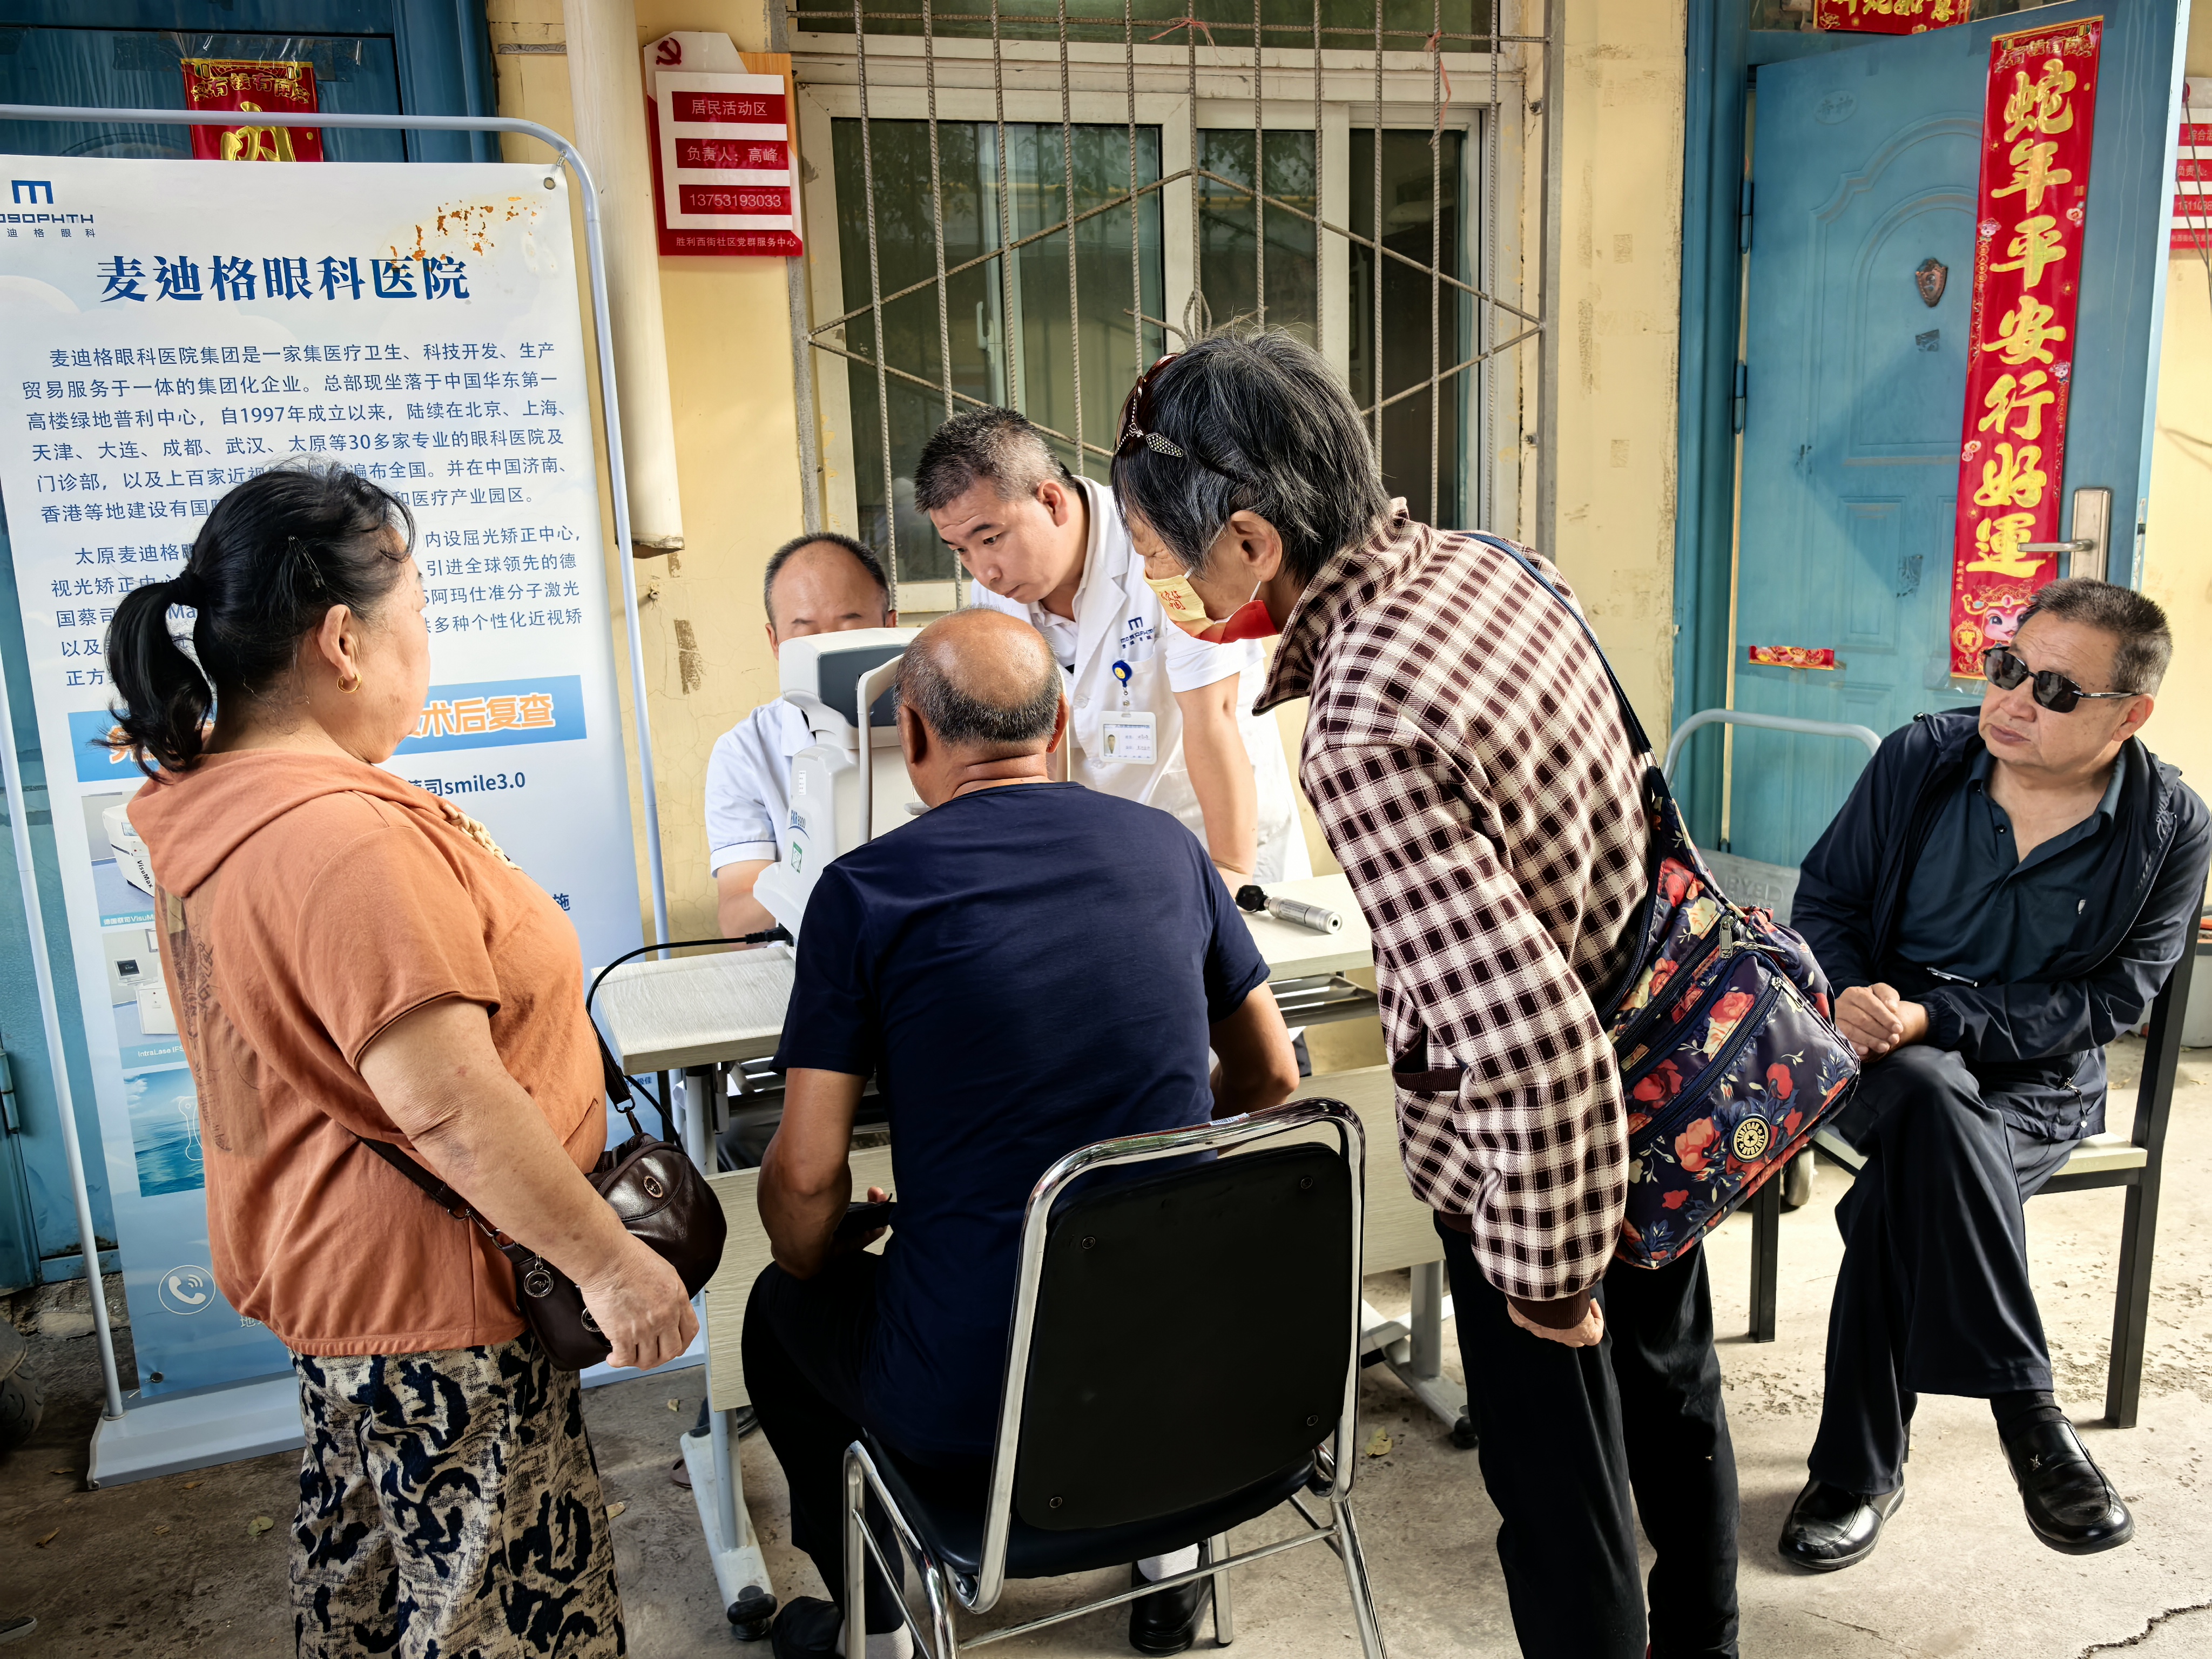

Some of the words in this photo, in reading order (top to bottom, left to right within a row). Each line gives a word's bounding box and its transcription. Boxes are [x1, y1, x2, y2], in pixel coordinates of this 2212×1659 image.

[691, 99, 767, 117] 居民活动区
[689, 193, 782, 207] 13753193033
[676, 237, 797, 248] 胜利西街社区党群服务中心
[96, 255, 470, 303] 麦迪格眼科医院
[49, 341, 555, 368] 麦迪格眼科医院集团是一家集医疗卫生、科技开发、生产
[22, 371, 558, 400] 贸易服务于一体的集团化企业。总部现坐落于中国华东第一
[26, 399, 566, 431] 高楼绿地普利中心，自1997年成立以来，陆续在北京、上海、
[32, 427, 564, 462] 天津、大连、成都、武汉、太原等30多家专业的眼科医院及
[37, 465, 272, 493] 门诊部，以及上百家近视
[41, 498, 221, 524] 香港等地建设有国
[425, 524, 580, 549] 内设屈光矫正中心，
[426, 552, 577, 577] 引进全球领先的德
[409, 693, 555, 738] 术后复查
[137, 860, 153, 888] VisuMax
[138, 1048, 171, 1057] IntraLase
